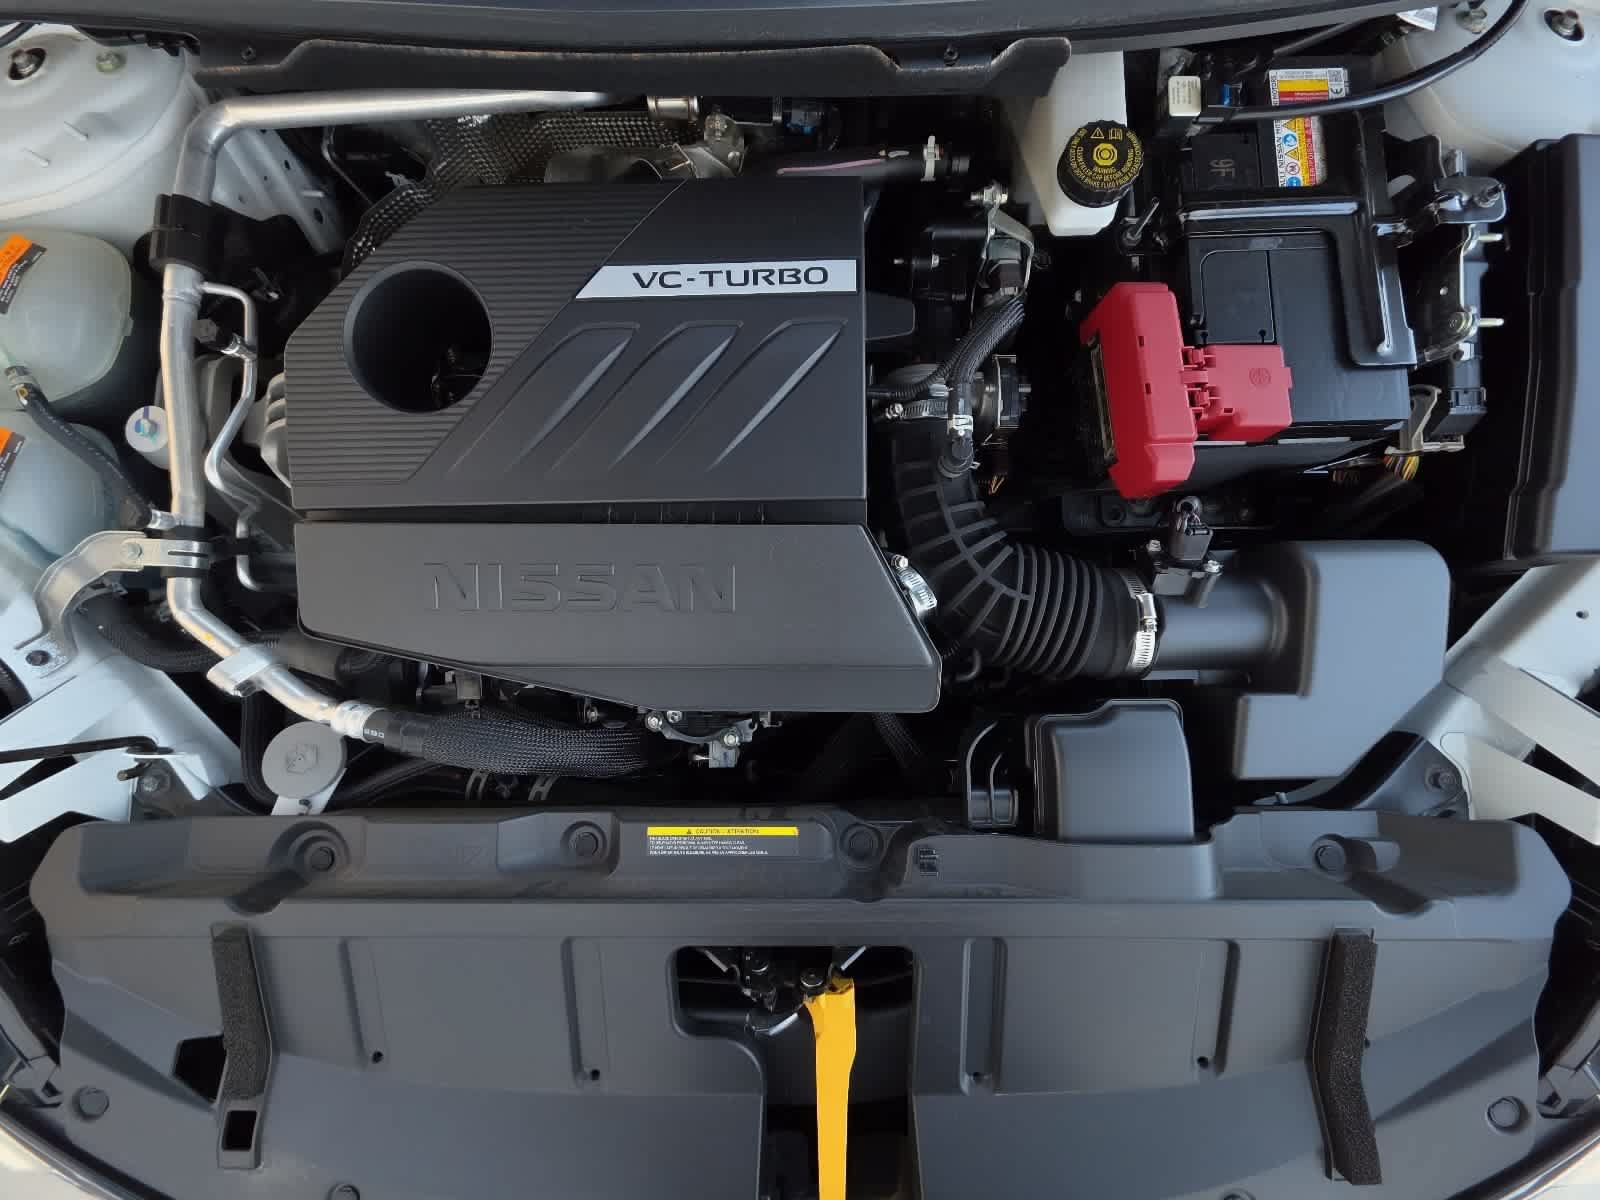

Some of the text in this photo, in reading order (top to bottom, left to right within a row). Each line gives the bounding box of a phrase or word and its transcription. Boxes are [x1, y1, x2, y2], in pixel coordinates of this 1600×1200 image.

[1276, 137, 1285, 168] NISSAN
[632, 266, 829, 289] VC-TURBO
[423, 562, 736, 612] NISSAN
